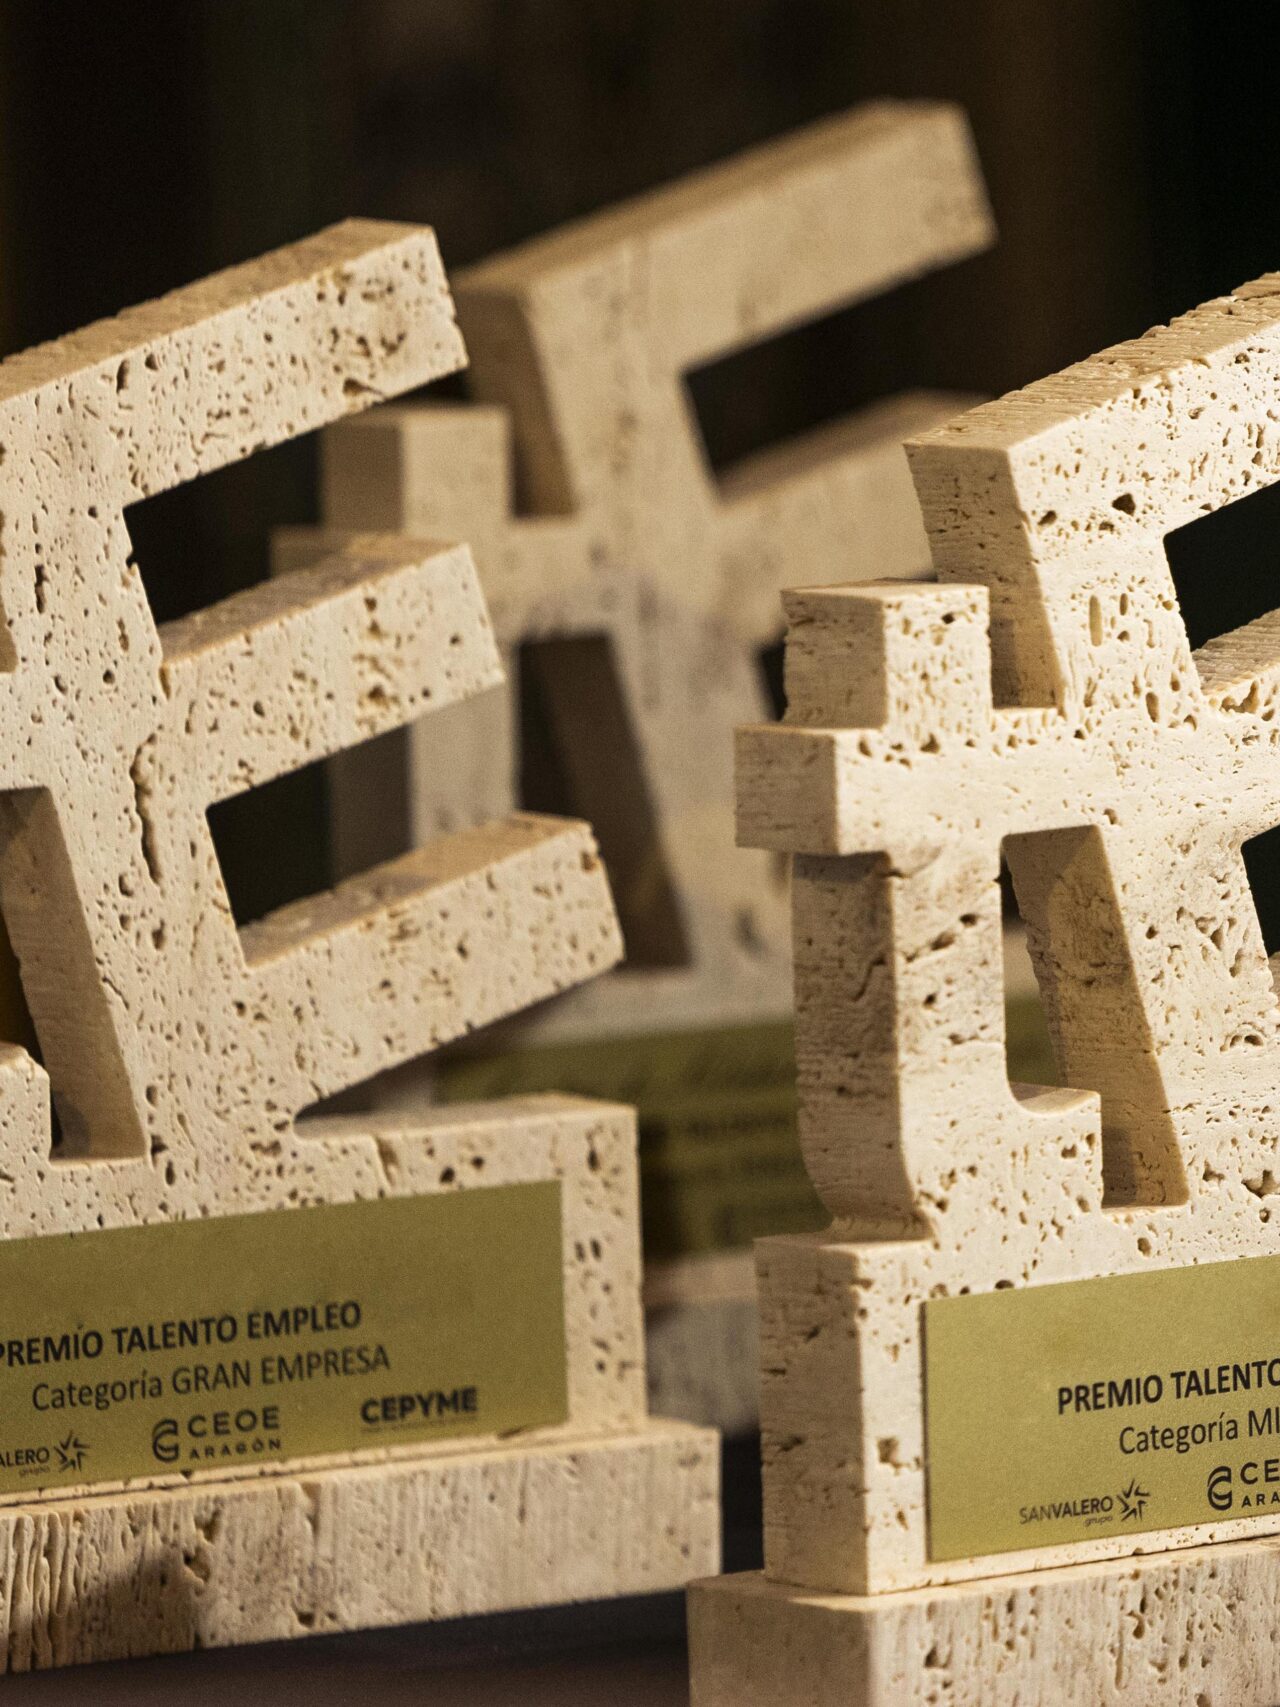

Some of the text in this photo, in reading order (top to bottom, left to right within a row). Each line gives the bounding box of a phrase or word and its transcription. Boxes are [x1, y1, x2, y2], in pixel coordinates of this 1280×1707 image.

[112, 1315, 238, 1355] TALENTO
[247, 1301, 361, 1340] EMPLEO
[32, 1344, 391, 1411] Categoría GRAN EMPRESA
[1058, 1374, 1163, 1415] PREMIO
[188, 1405, 280, 1437] CEOE
[360, 1386, 478, 1425] CEPYME
[1119, 1412, 1238, 1455] Categoría
[1019, 1495, 1113, 1525] SANVALERO
